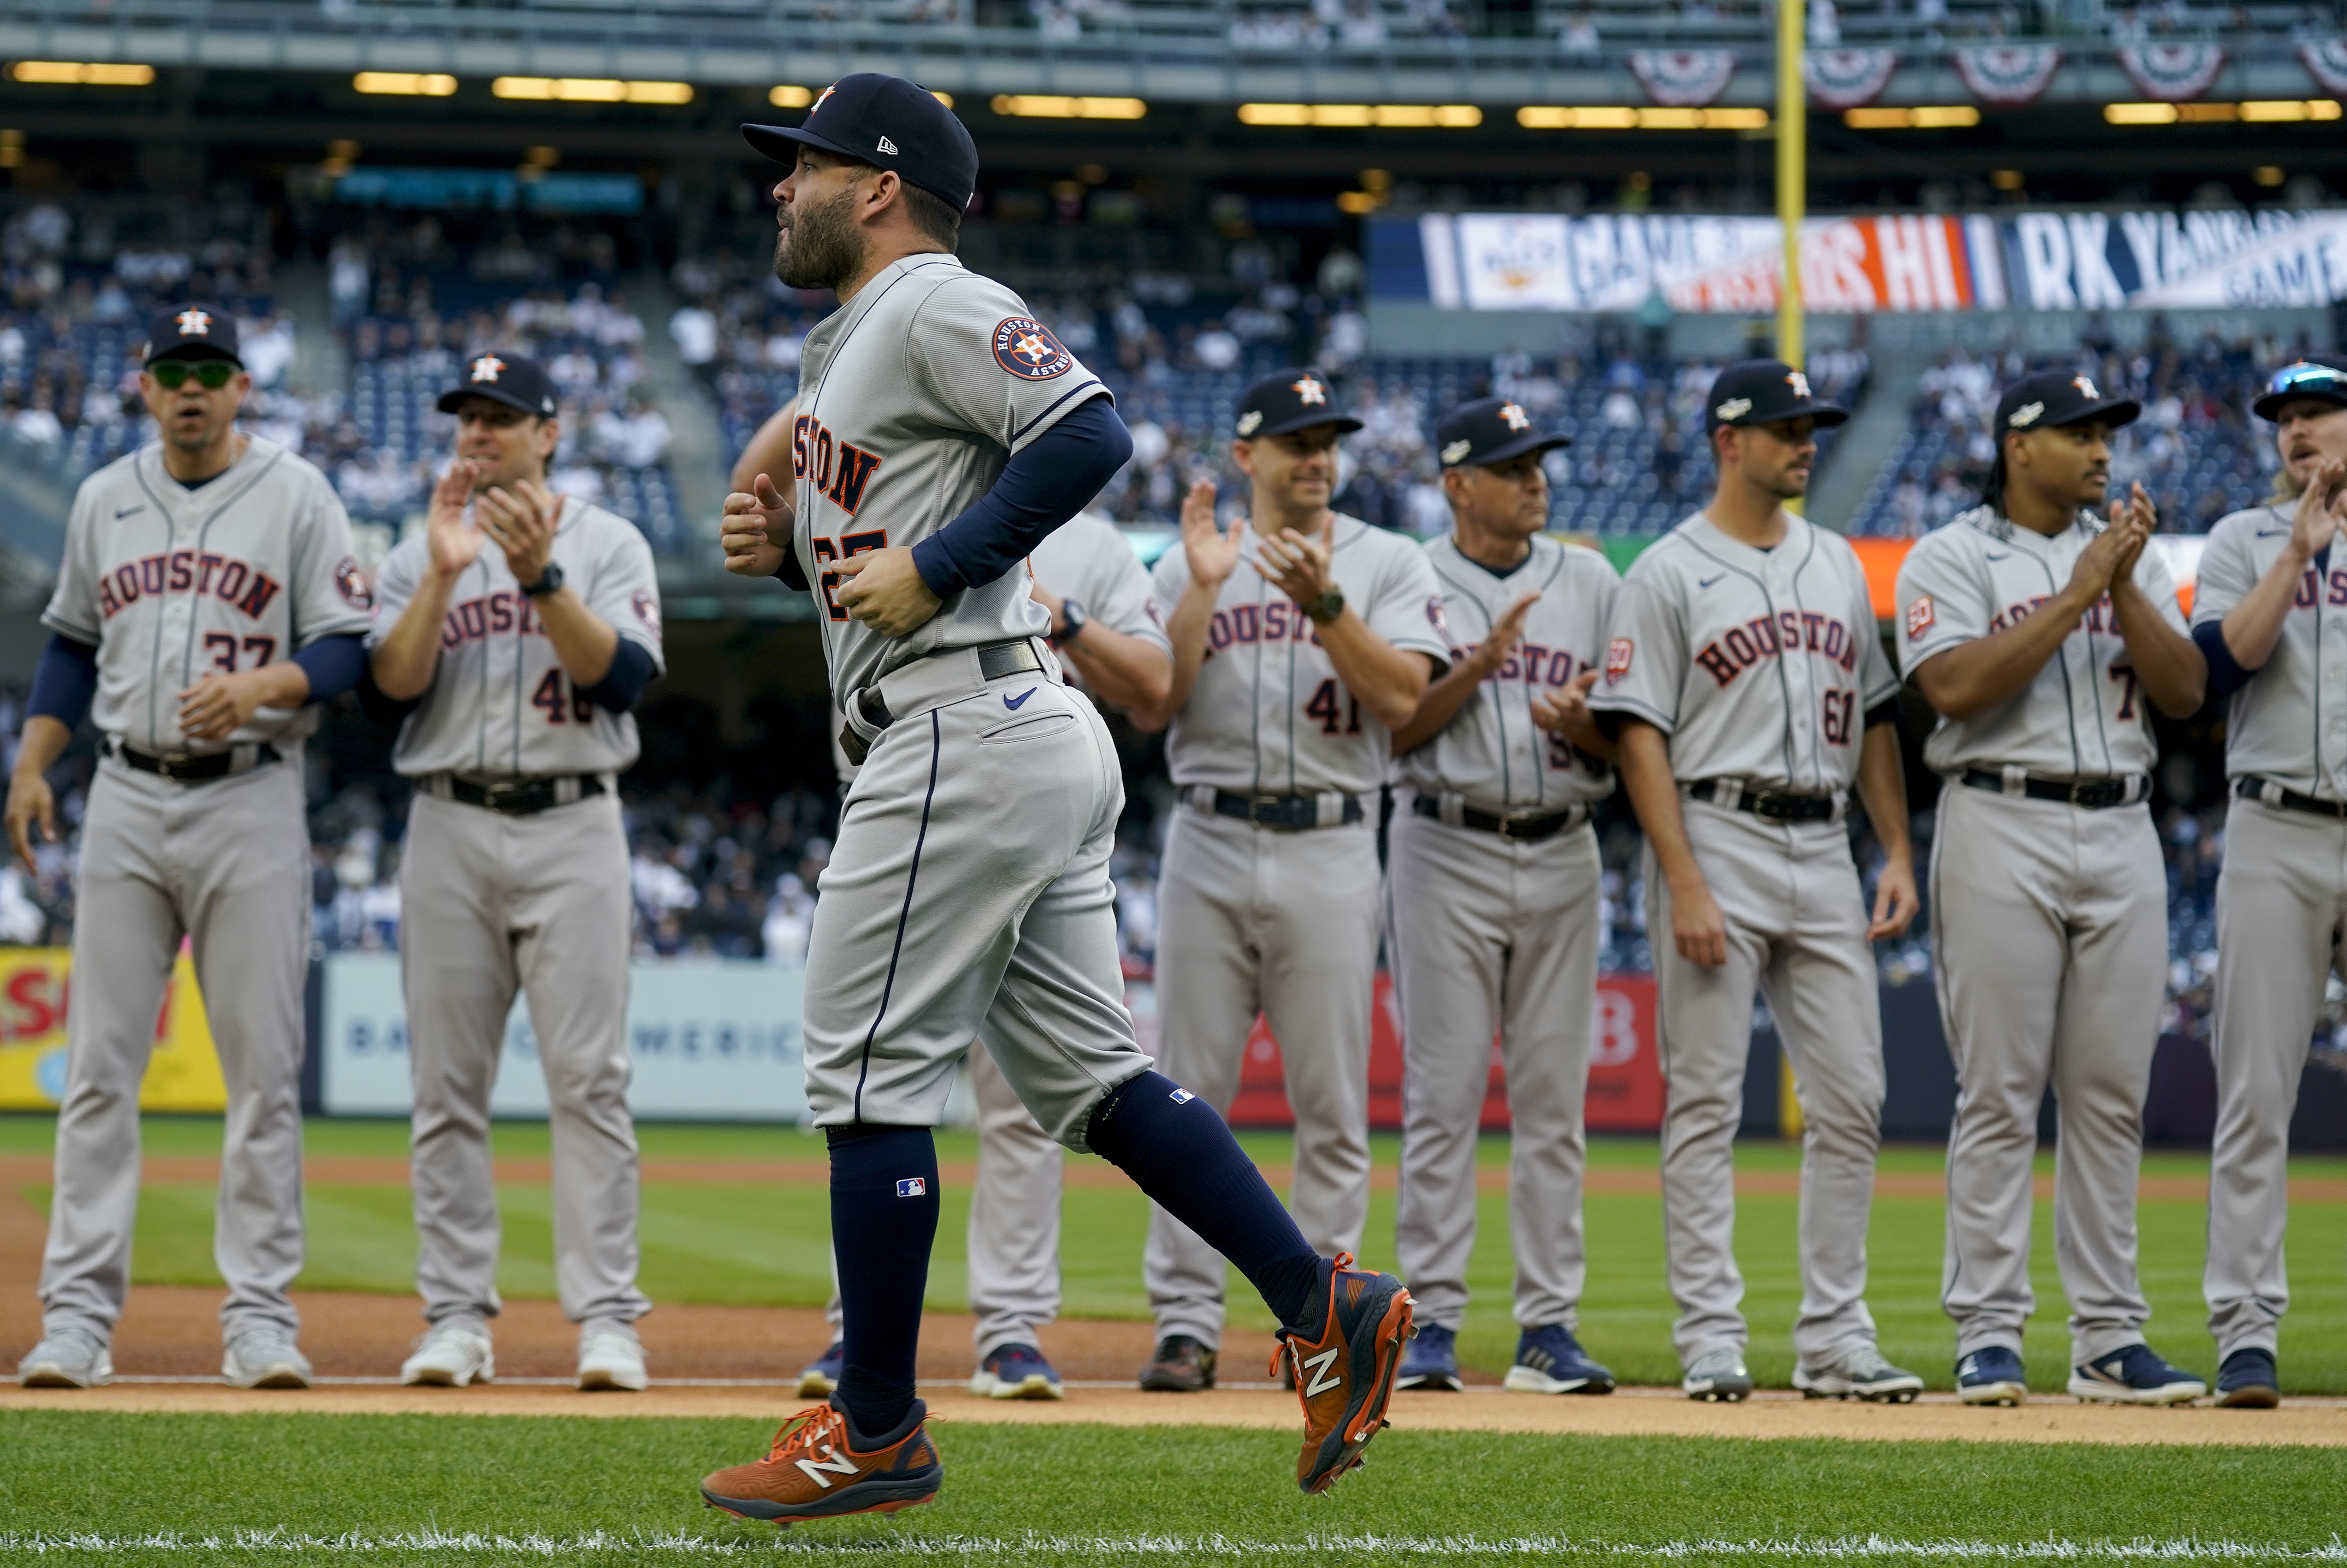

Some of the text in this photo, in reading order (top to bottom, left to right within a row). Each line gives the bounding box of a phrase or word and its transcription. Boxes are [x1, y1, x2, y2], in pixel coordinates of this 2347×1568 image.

[998, 320, 1040, 350] HOUSTON
[1031, 352, 1069, 376] ASTROS
[98, 550, 280, 619] HOUSTON
[1203, 601, 1323, 660] OUST
[1695, 609, 1857, 688] HOUSTON
[1304, 678, 1362, 734] 41
[1824, 689, 1855, 745] 61
[2109, 666, 2136, 721] 7
